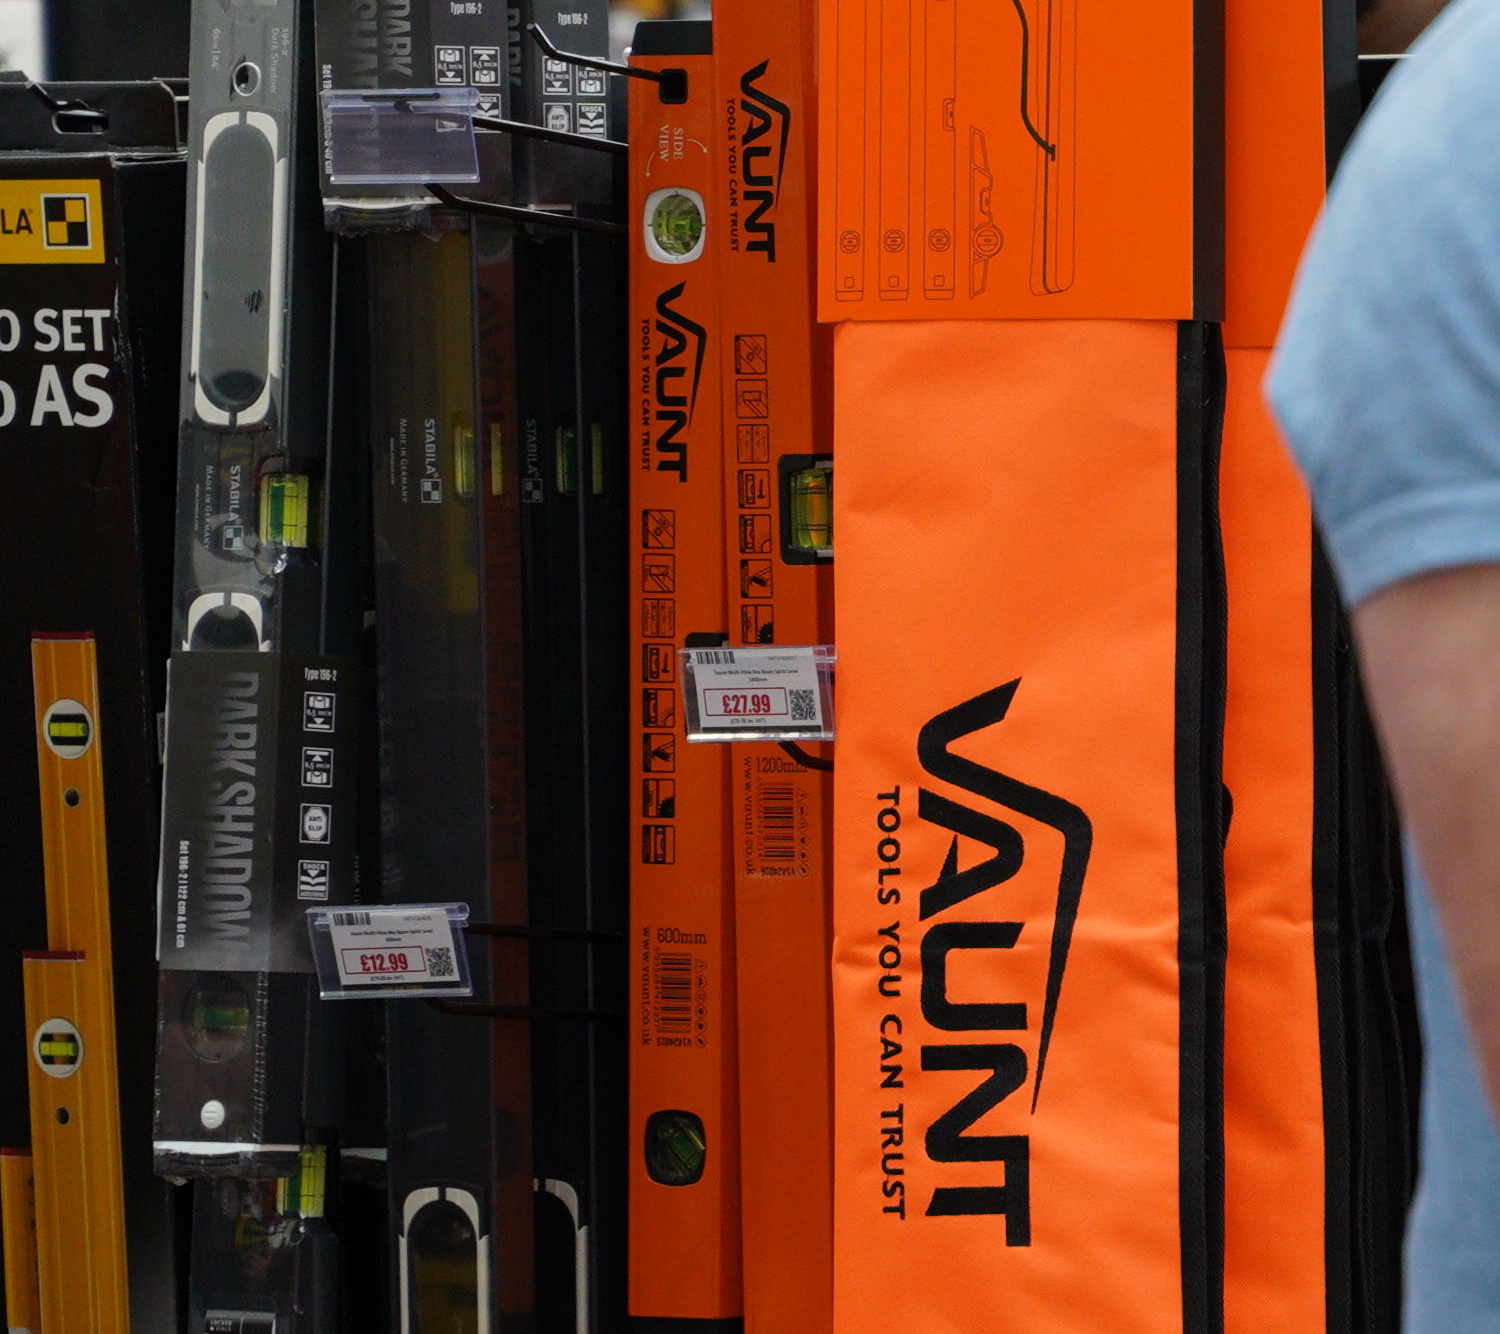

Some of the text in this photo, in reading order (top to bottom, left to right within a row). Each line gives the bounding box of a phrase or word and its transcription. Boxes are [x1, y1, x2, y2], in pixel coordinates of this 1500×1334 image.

[660, 124, 671, 162] VIEW
[673, 127, 684, 161] SIDE
[727, 98, 740, 253] TOOLS YOU CAN TRUST
[741, 58, 791, 263] VAUNT
[33, 307, 112, 353] SET
[29, 363, 114, 428] AS
[641, 318, 651, 472] TOOLS YOU CAN TRUST
[656, 280, 707, 484] VAUNT
[424, 418, 437, 475] STABILA
[525, 418, 538, 475] STABILA
[229, 465, 241, 522] STABILA
[722, 694, 771, 714] £27.99
[200, 671, 259, 949] DARK SHADOW
[743, 755, 755, 877] www.vaunt.co.uk
[360, 952, 409, 972] £12.99
[657, 927, 708, 944] 600mm
[917, 676, 1093, 1246] VAUNT
[641, 925, 652, 1047] www.vaunt.co.uk
[876, 785, 906, 1219] TOOLS YOU CAN TRUST
